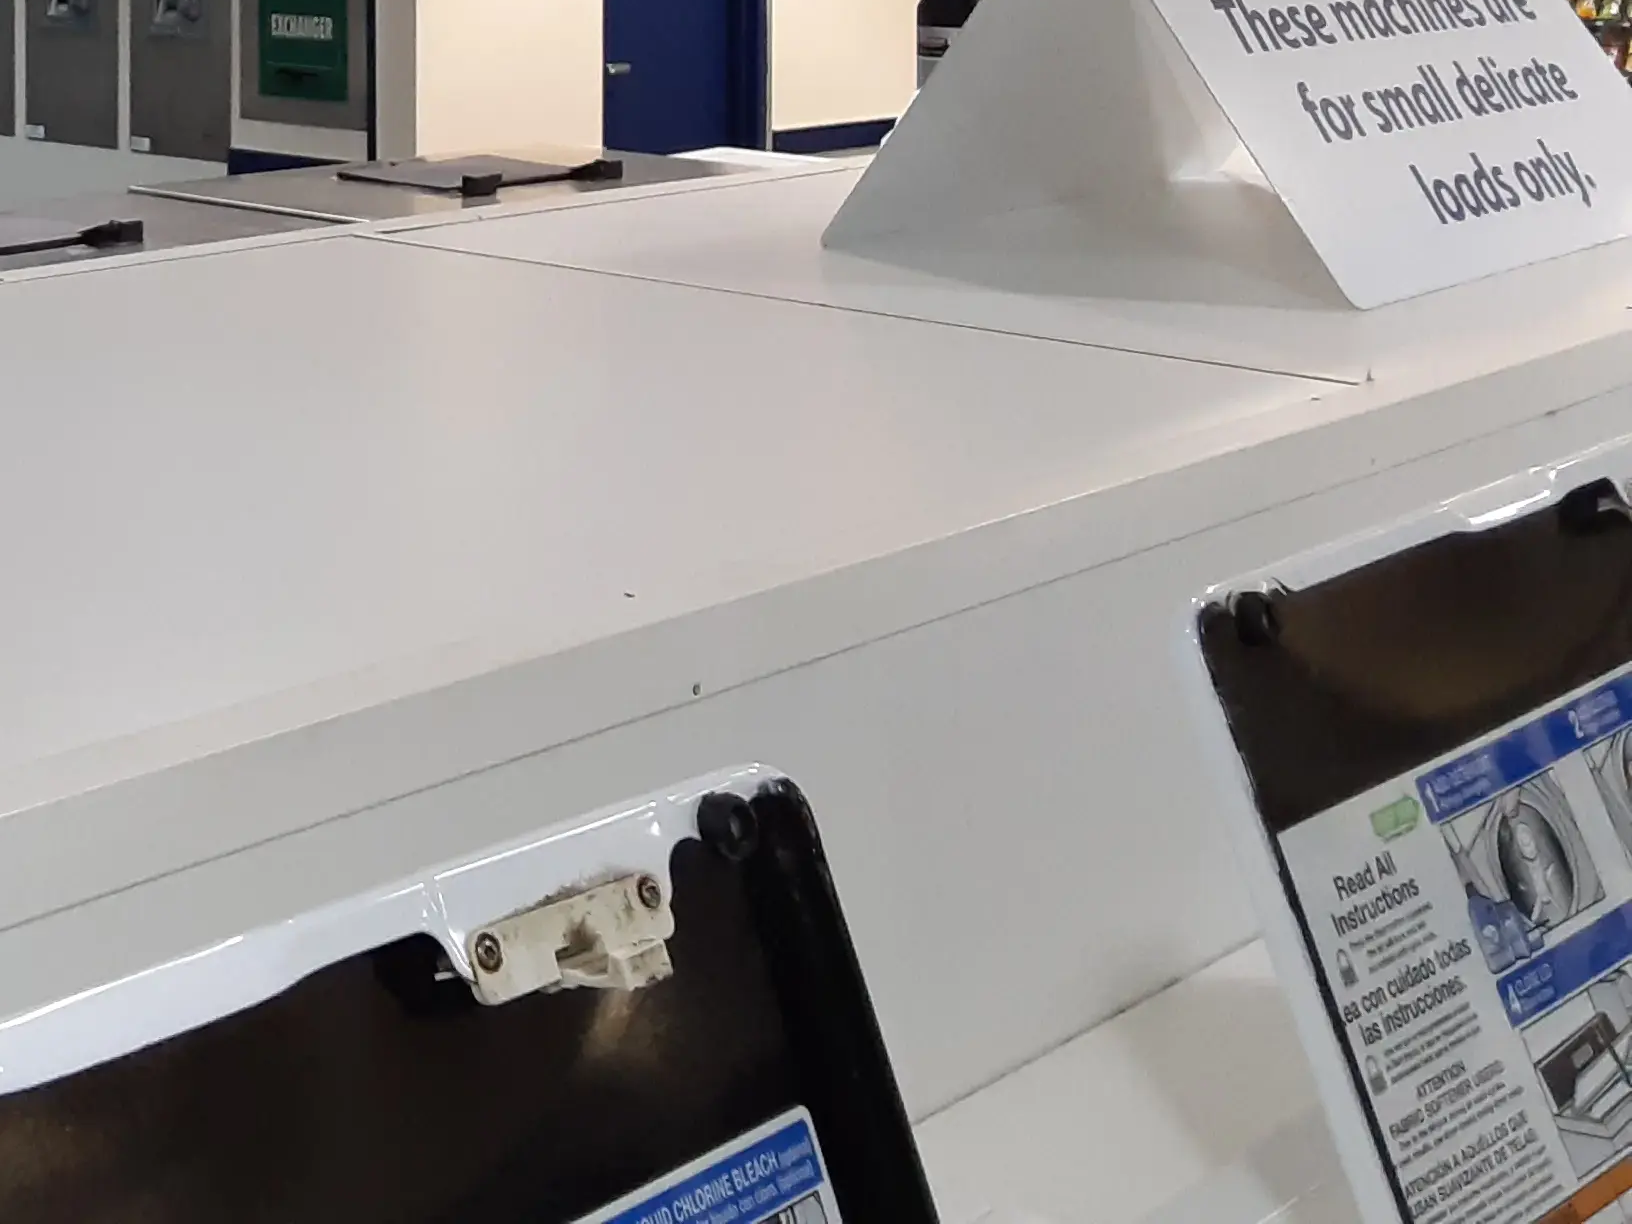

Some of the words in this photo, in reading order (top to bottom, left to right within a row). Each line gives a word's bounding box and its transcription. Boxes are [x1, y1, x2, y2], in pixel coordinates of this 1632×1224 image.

[271, 13, 333, 40] EXCHANGER
[1296, 80, 1367, 145] for
[1361, 64, 1463, 135] small
[1453, 56, 1580, 118] delicate
[1409, 152, 1520, 225] loads
[1513, 137, 1597, 208] only.
[1333, 861, 1376, 901] Read
[1375, 851, 1398, 879] All
[1331, 878, 1420, 938] Instructions
[1343, 1001, 1362, 1024] ea
[1361, 986, 1388, 1013] con
[1387, 958, 1436, 998] cuidado
[1358, 1020, 1382, 1046] las
[672, 1174, 734, 1223] CHLORINE
[730, 1150, 780, 1197] BLEACH
